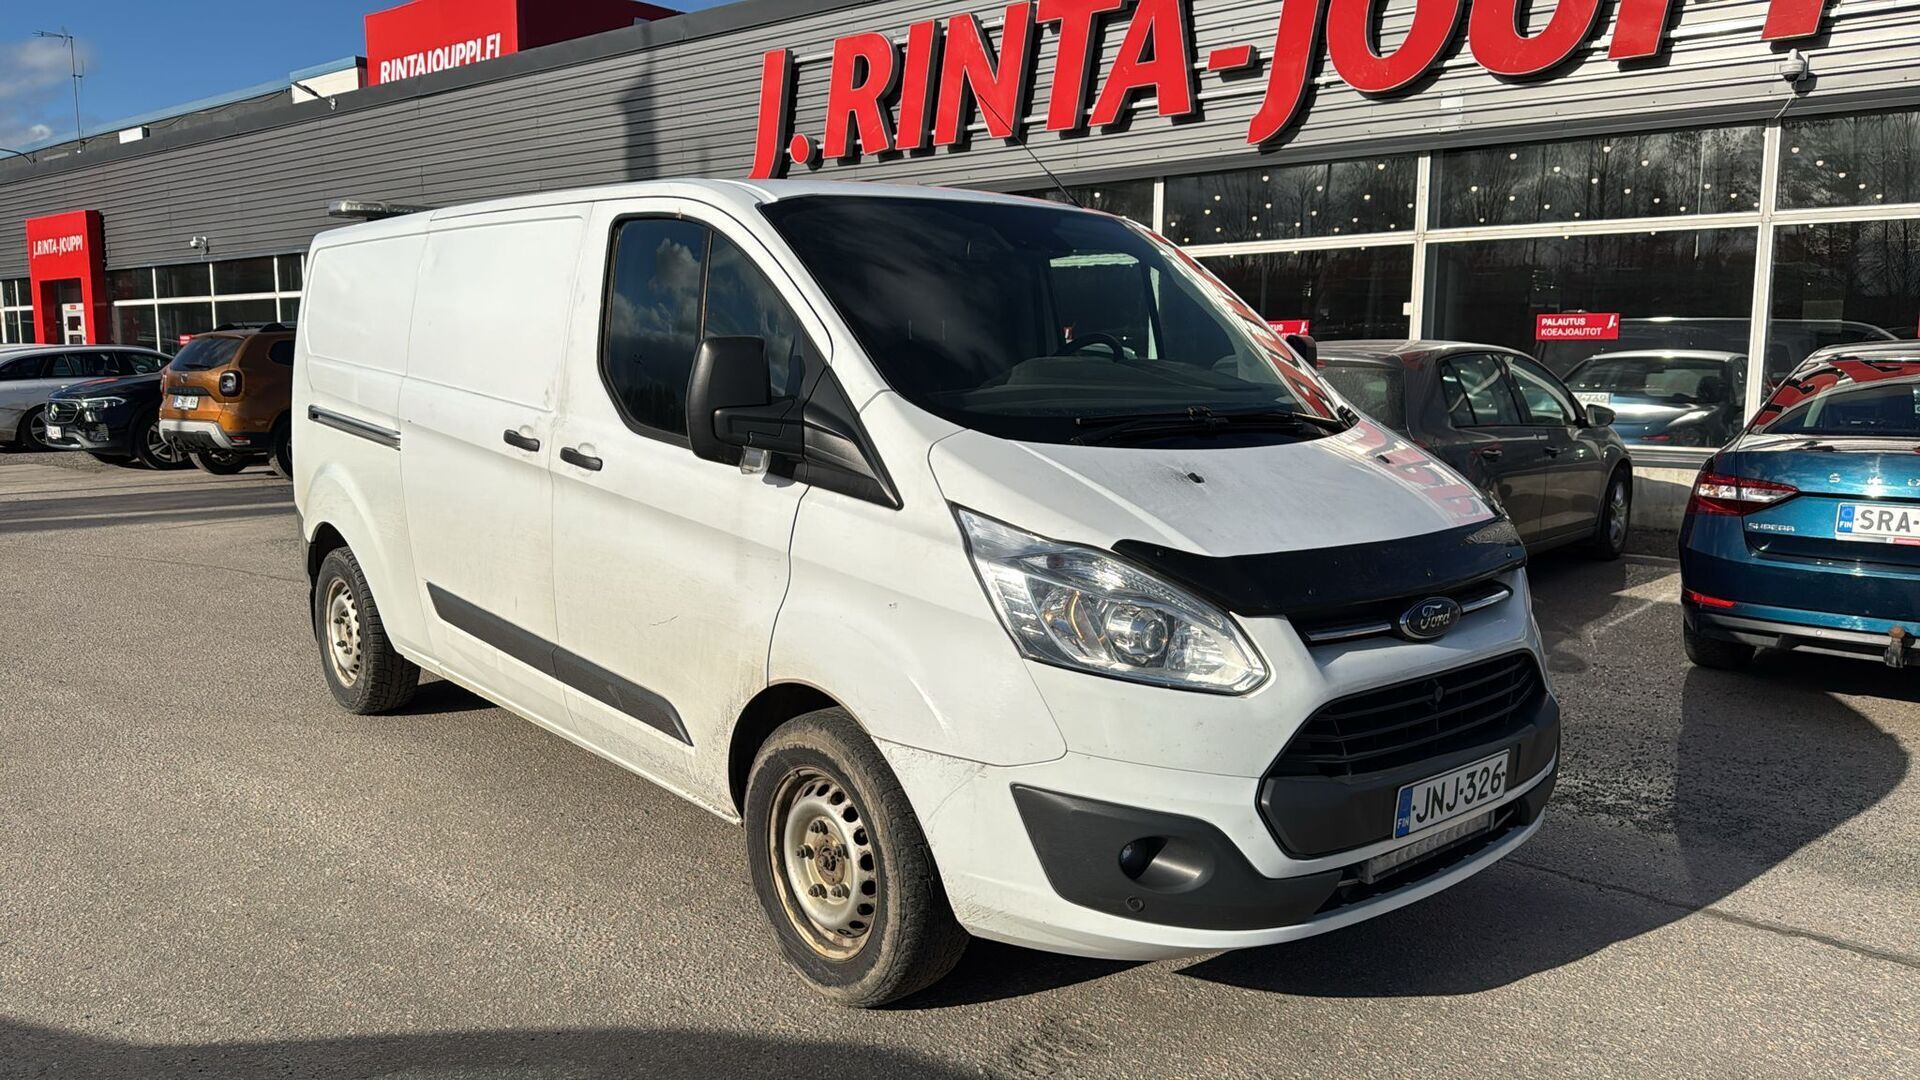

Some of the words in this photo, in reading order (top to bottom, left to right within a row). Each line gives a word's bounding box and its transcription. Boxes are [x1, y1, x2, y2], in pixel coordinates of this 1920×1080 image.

[1541, 318, 1586, 326] PALAUTUS
[1541, 328, 1602, 336] KOEAJOAUTOT
[1420, 604, 1451, 630] Ford
[1416, 760, 1503, 823] JNJ-326
